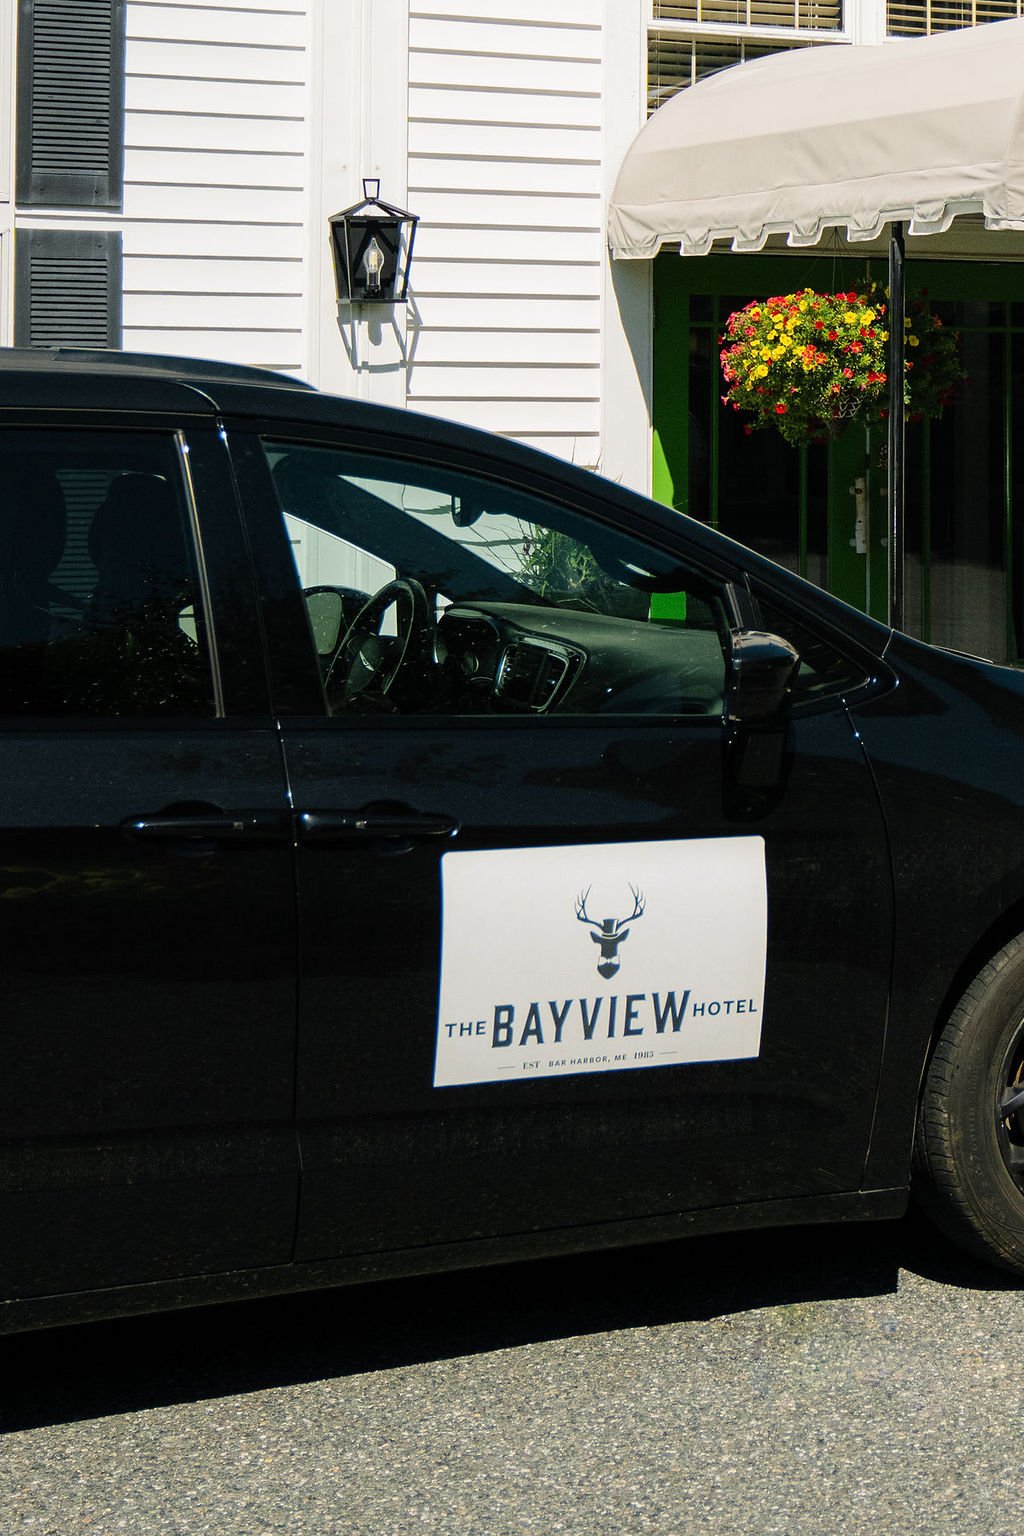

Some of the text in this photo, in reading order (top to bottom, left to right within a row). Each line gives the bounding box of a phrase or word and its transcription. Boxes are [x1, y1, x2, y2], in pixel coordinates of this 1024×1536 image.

[445, 990, 758, 1049] THE BAYVIEW HOTEL
[522, 1051, 655, 1070] EST BAR HARBOR, ME 1985
